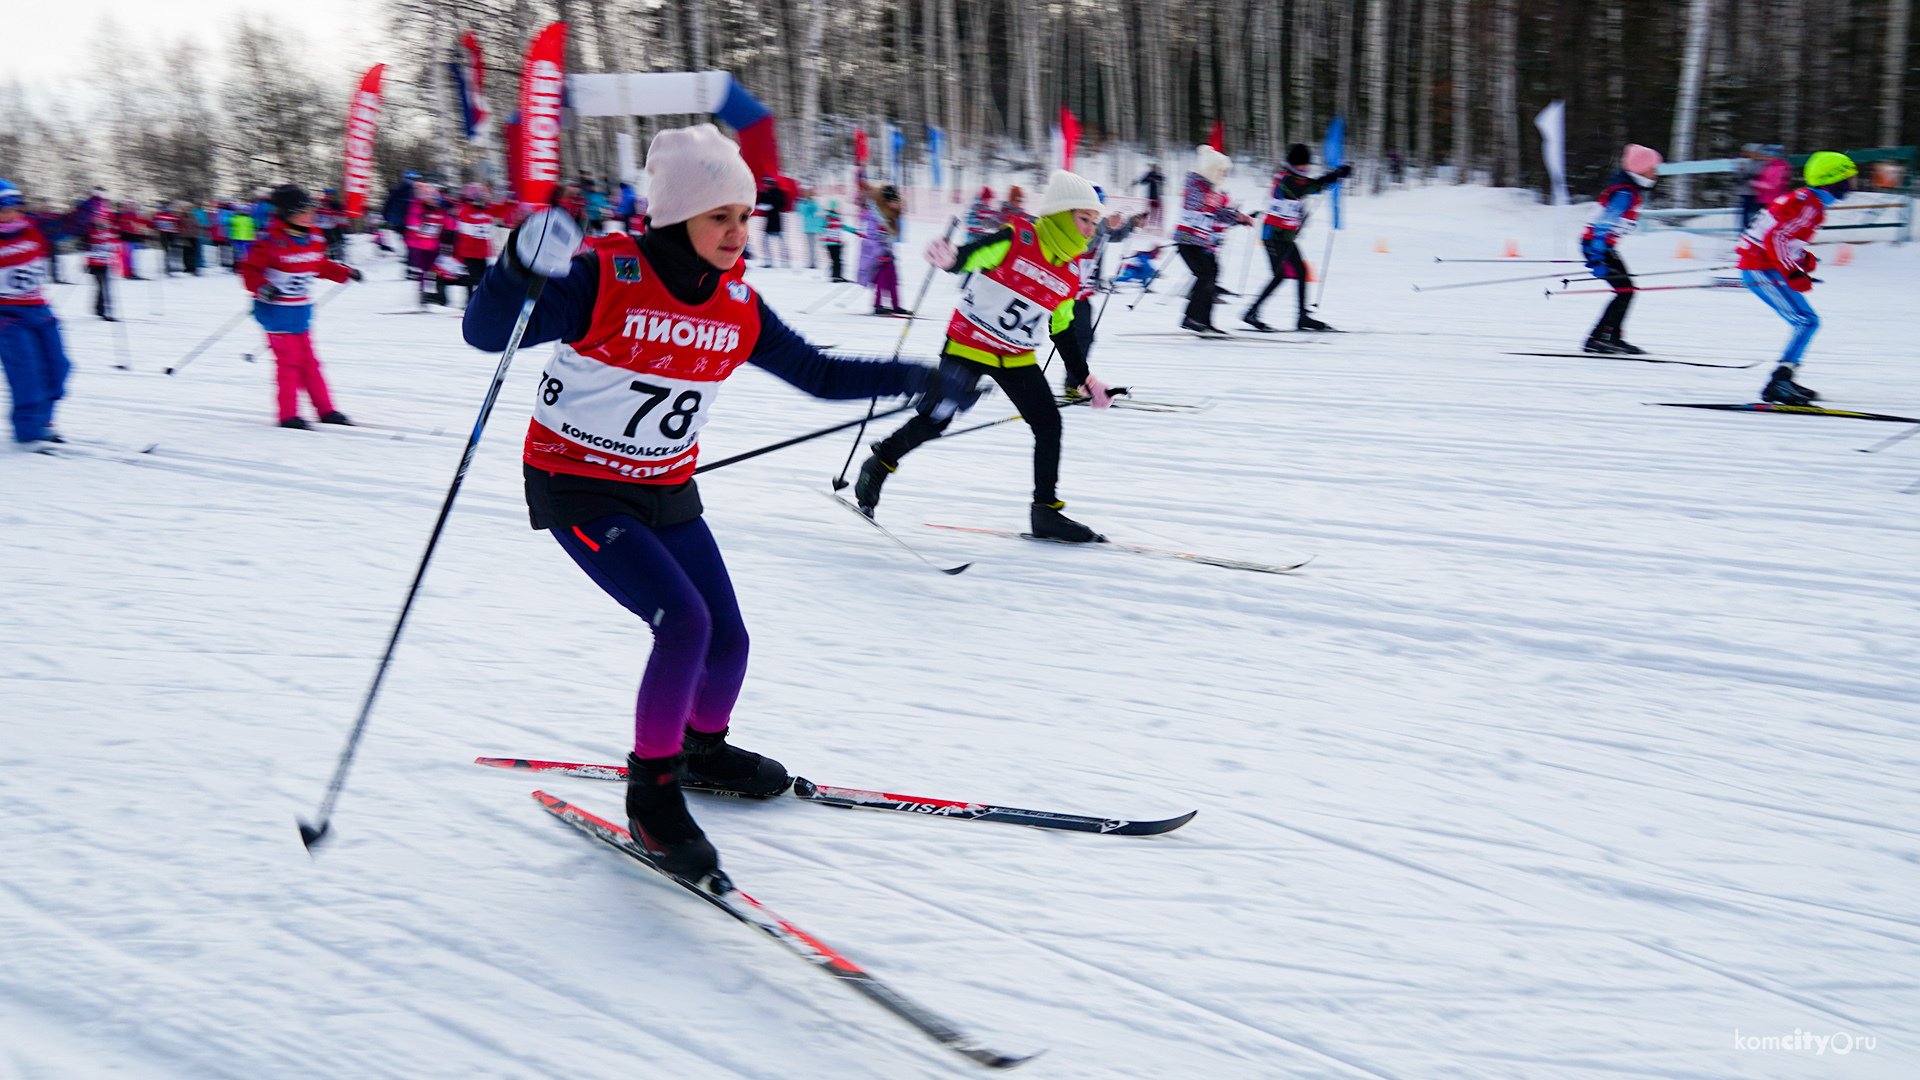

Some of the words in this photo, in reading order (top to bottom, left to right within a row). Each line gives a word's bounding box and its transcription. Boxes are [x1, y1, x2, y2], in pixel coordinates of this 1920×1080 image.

[622, 314, 739, 353] ПИОНЕР
[999, 298, 1044, 338] 54
[623, 381, 702, 440] 78
[713, 790, 740, 798] TISA
[895, 801, 950, 816] TISA
